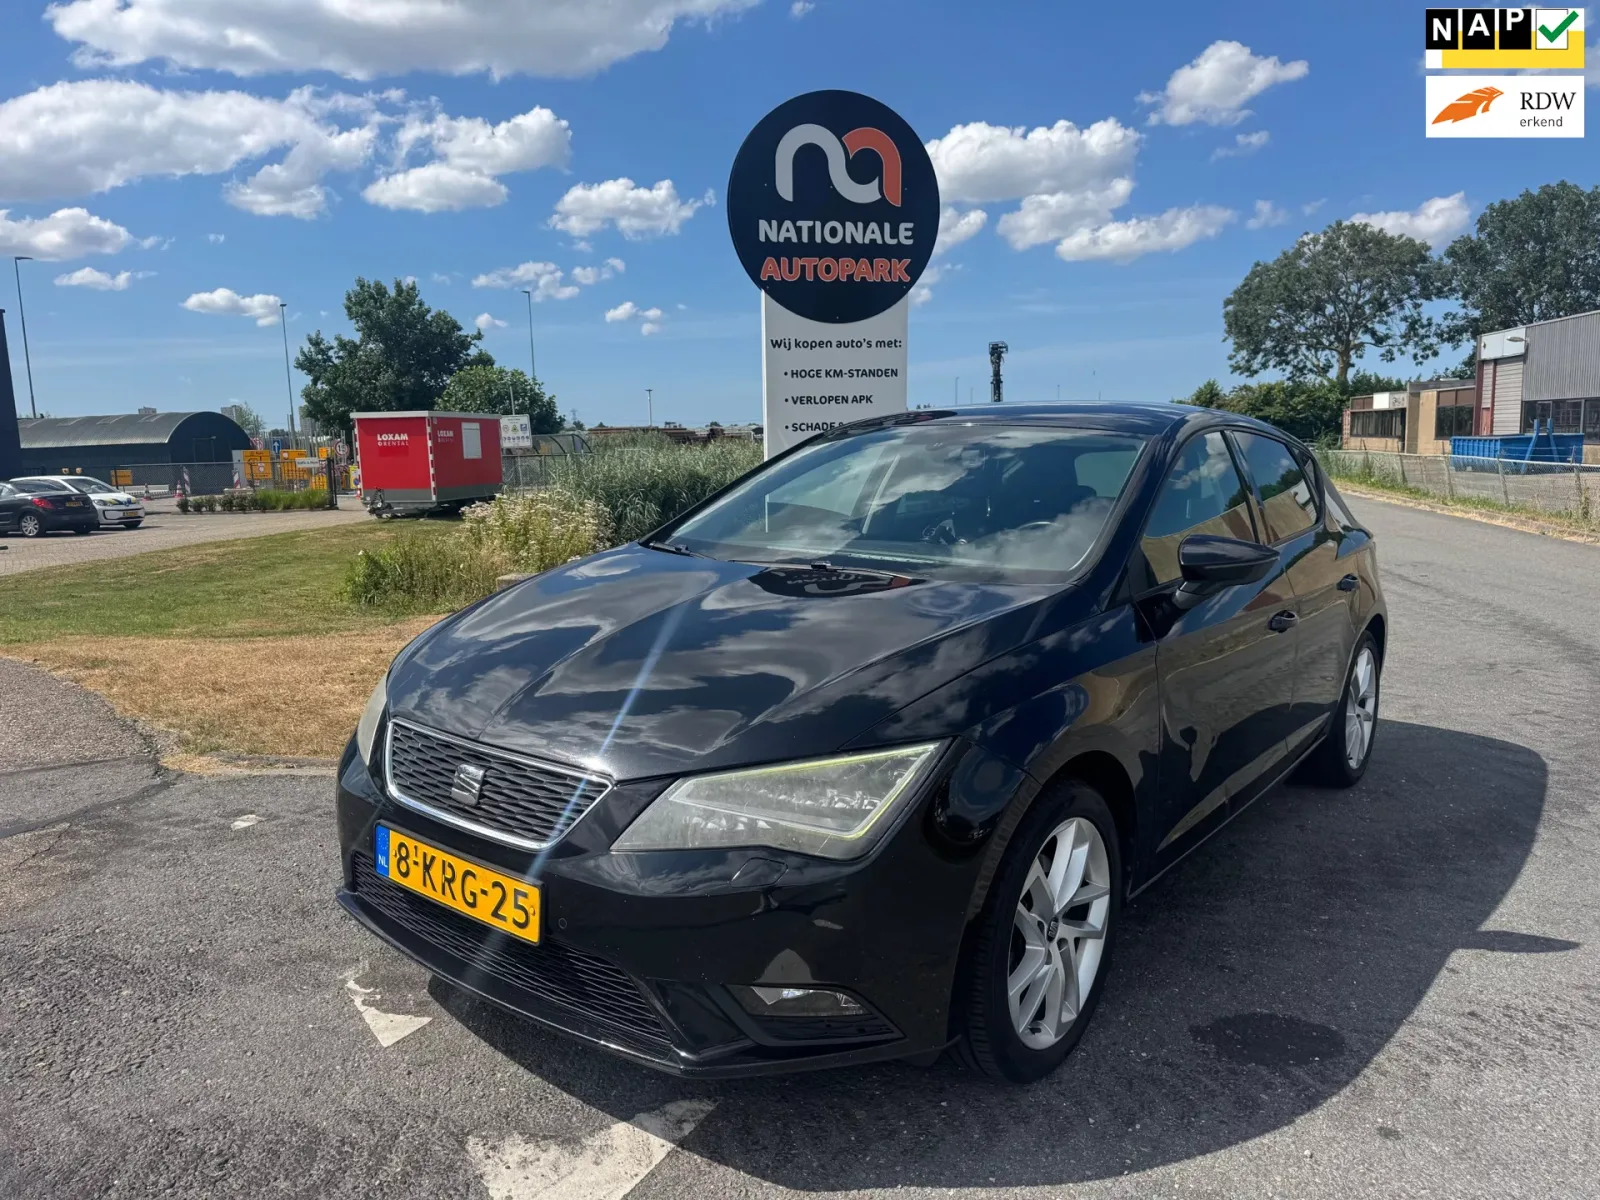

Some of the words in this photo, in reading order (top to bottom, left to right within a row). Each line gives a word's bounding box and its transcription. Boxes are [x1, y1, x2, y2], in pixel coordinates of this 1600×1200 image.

[758, 219, 914, 245] NATIONALE
[760, 257, 911, 282] AUTOPARK
[770, 338, 791, 351] Wij
[794, 338, 833, 351] kopen
[835, 338, 872, 349] auto's
[875, 339, 902, 348] met:
[790, 369, 822, 378] HOGE
[824, 368, 898, 378] KM-STANDEN
[791, 396, 849, 405] VERLOPEN
[851, 395, 873, 404] APK
[377, 433, 409, 441] LOXAM
[378, 853, 388, 868] NL
[396, 841, 530, 929] 8-KRG-25
